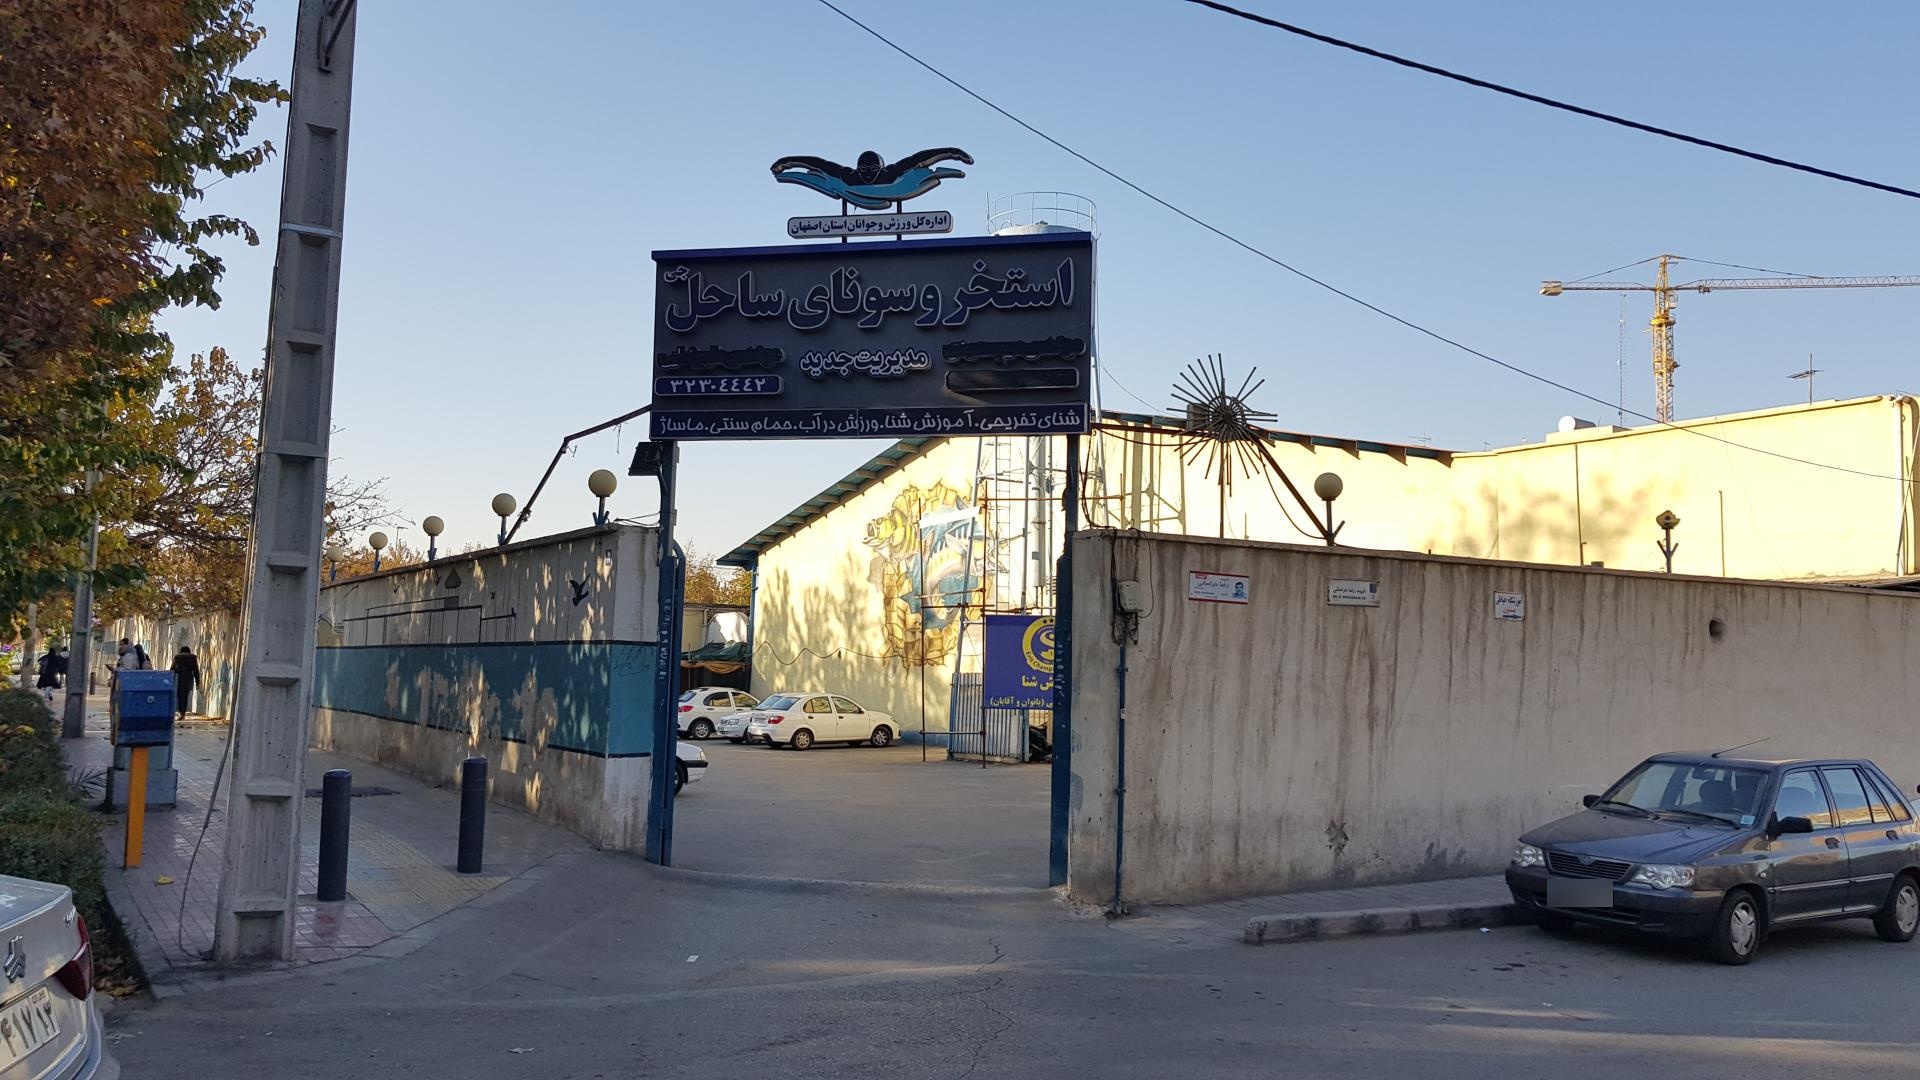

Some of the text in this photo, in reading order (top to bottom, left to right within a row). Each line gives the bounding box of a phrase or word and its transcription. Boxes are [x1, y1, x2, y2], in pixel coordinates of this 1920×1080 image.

[790, 221, 822, 234] اصفهان
[822, 219, 847, 233] استان
[848, 217, 878, 232] جوانان
[884, 217, 911, 231] ورزش
[911, 216, 925, 229] کل
[925, 215, 947, 227] اداره
[665, 257, 1075, 332] استخر و سونای ساحل
[800, 351, 854, 376] جدید
[853, 349, 929, 375] مدیریت
[659, 416, 703, 434] ماساژ
[822, 418, 836, 432] در
[837, 414, 879, 433] ورزش
[913, 409, 975, 431] آموزش
[1037, 409, 1080, 429] شنای
[1021, 675, 1038, 687] شنا
